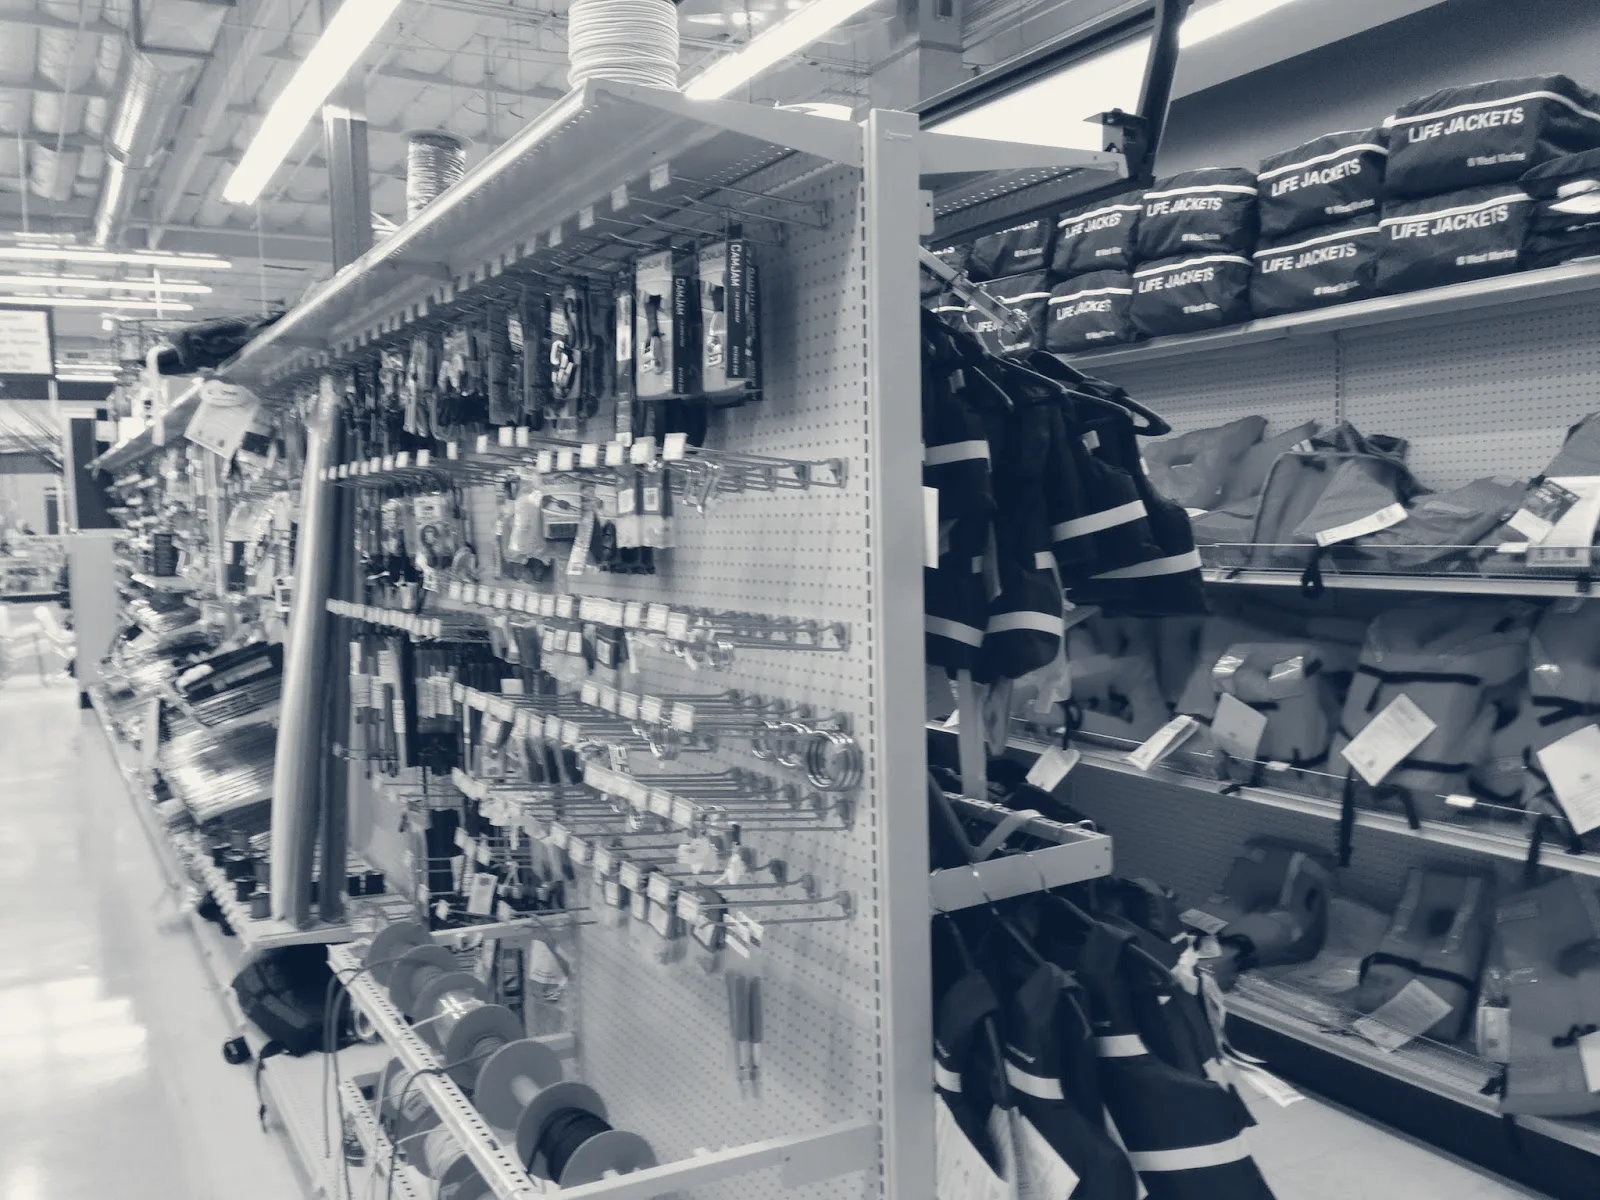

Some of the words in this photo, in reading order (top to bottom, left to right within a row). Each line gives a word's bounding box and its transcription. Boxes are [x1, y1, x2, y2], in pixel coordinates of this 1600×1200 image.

[1408, 122, 1444, 143] LIFE
[1444, 107, 1525, 135] JACKETS
[1271, 175, 1299, 197] LIFE
[1300, 158, 1362, 188] JACKETS
[1146, 201, 1171, 217] LIFE
[1170, 197, 1223, 213] JACKETS
[1391, 221, 1429, 240] LIFE
[1431, 204, 1509, 236] JACKETS
[1262, 256, 1293, 274] LIFE
[1295, 242, 1357, 269] JACKETS
[1138, 277, 1164, 294] LIFE
[1164, 267, 1215, 288] JACKETS
